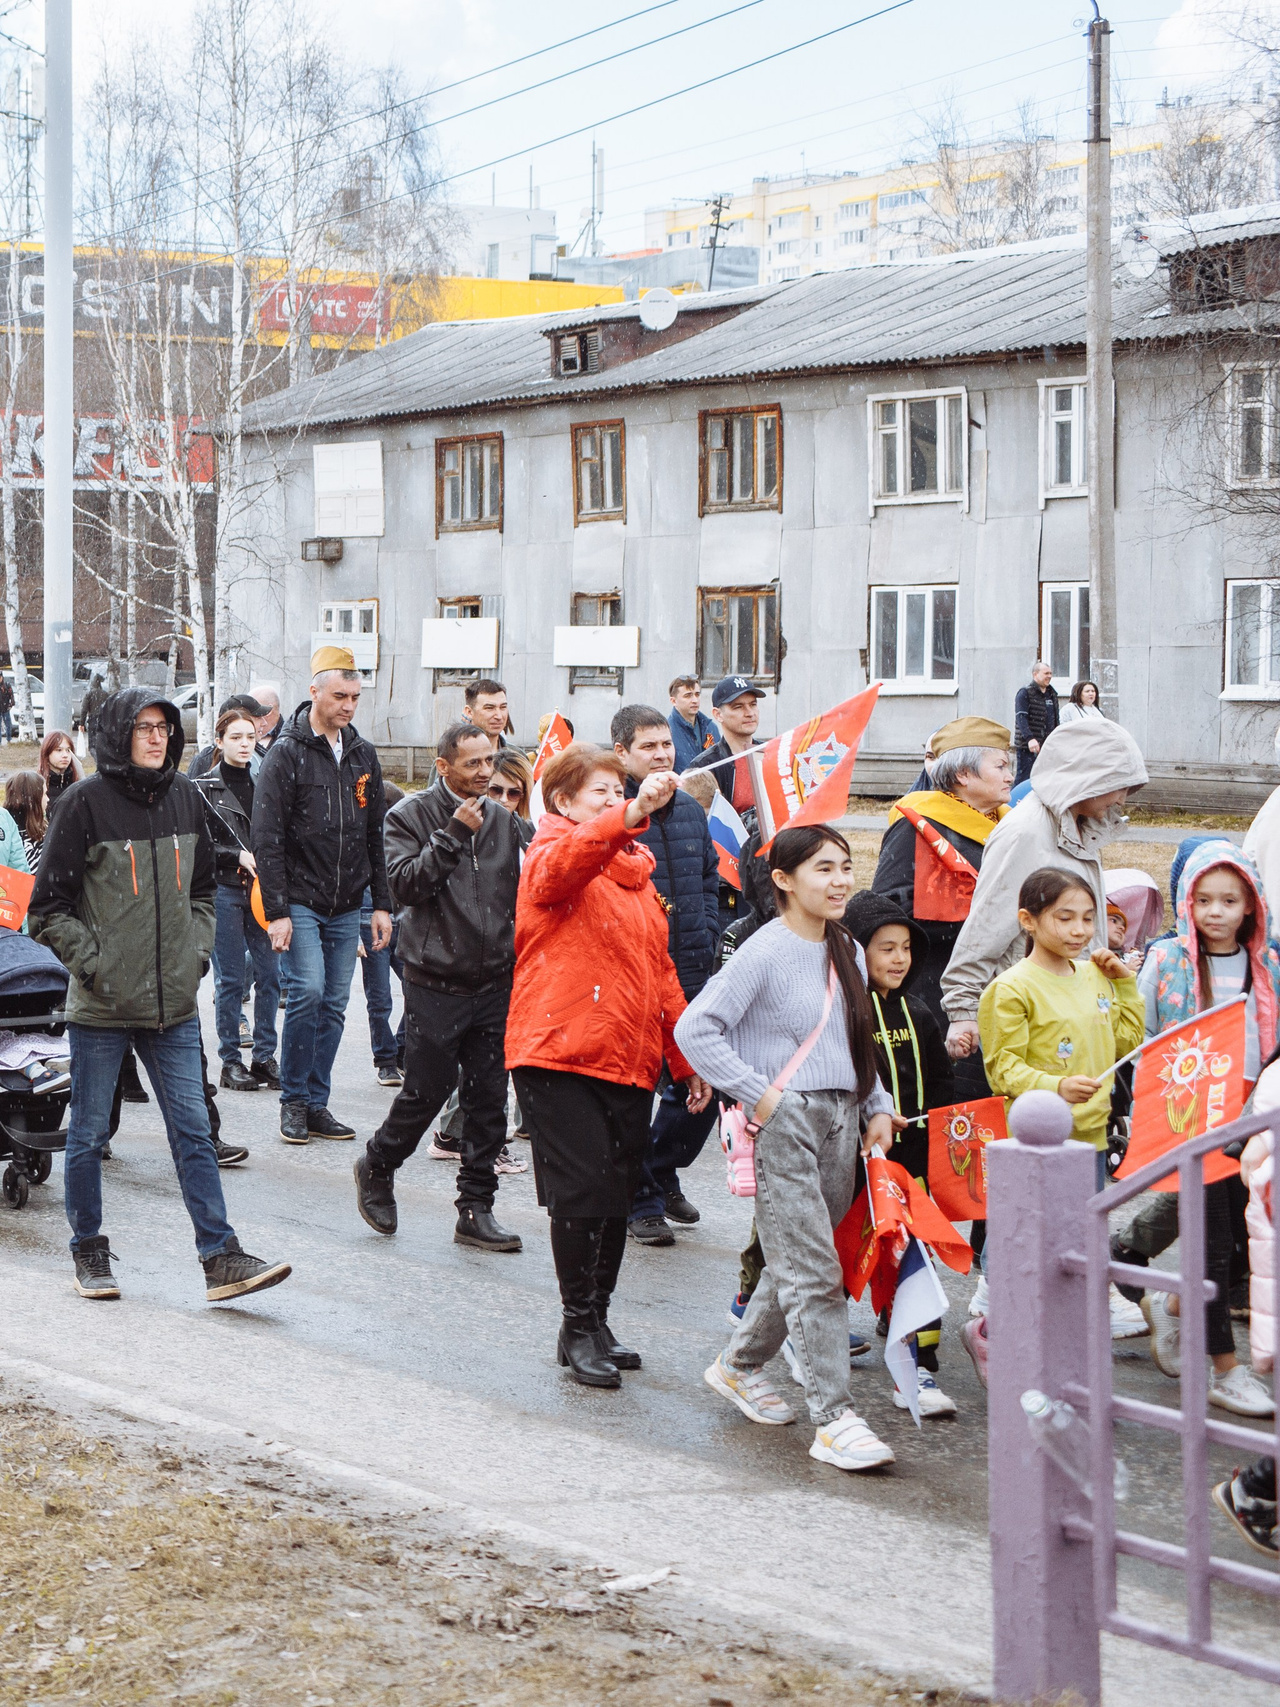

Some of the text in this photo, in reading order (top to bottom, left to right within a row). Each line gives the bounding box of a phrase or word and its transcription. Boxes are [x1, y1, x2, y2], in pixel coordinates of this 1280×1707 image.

[872, 1028, 912, 1044] REAM
[1206, 1054, 1232, 1132] 9 МА
